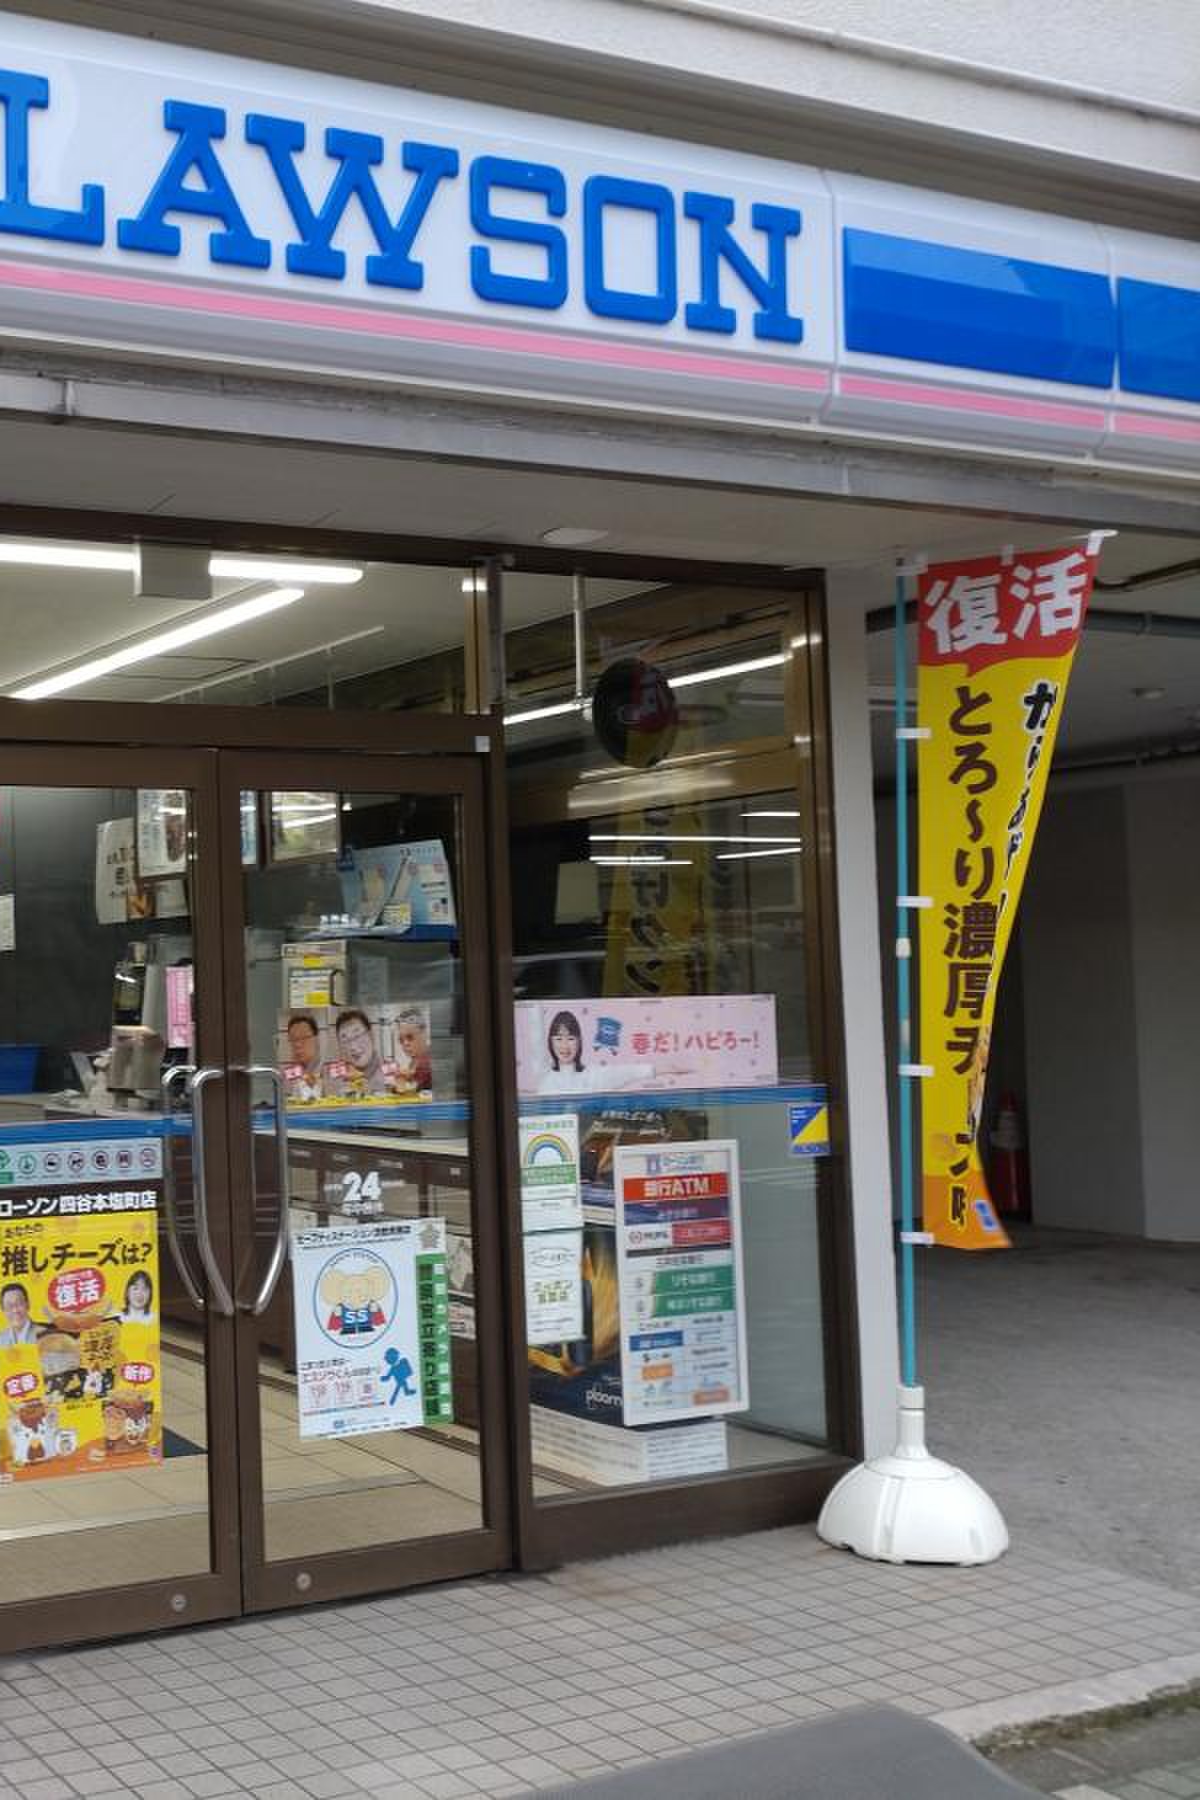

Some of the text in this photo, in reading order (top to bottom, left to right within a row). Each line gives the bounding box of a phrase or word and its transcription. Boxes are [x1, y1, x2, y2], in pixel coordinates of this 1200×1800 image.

[925, 552, 1087, 654] 復活
[342, 1171, 381, 1200] 24
[1, 1238, 153, 1276] 推しチーズは?
[56, 1278, 101, 1308] 復活
